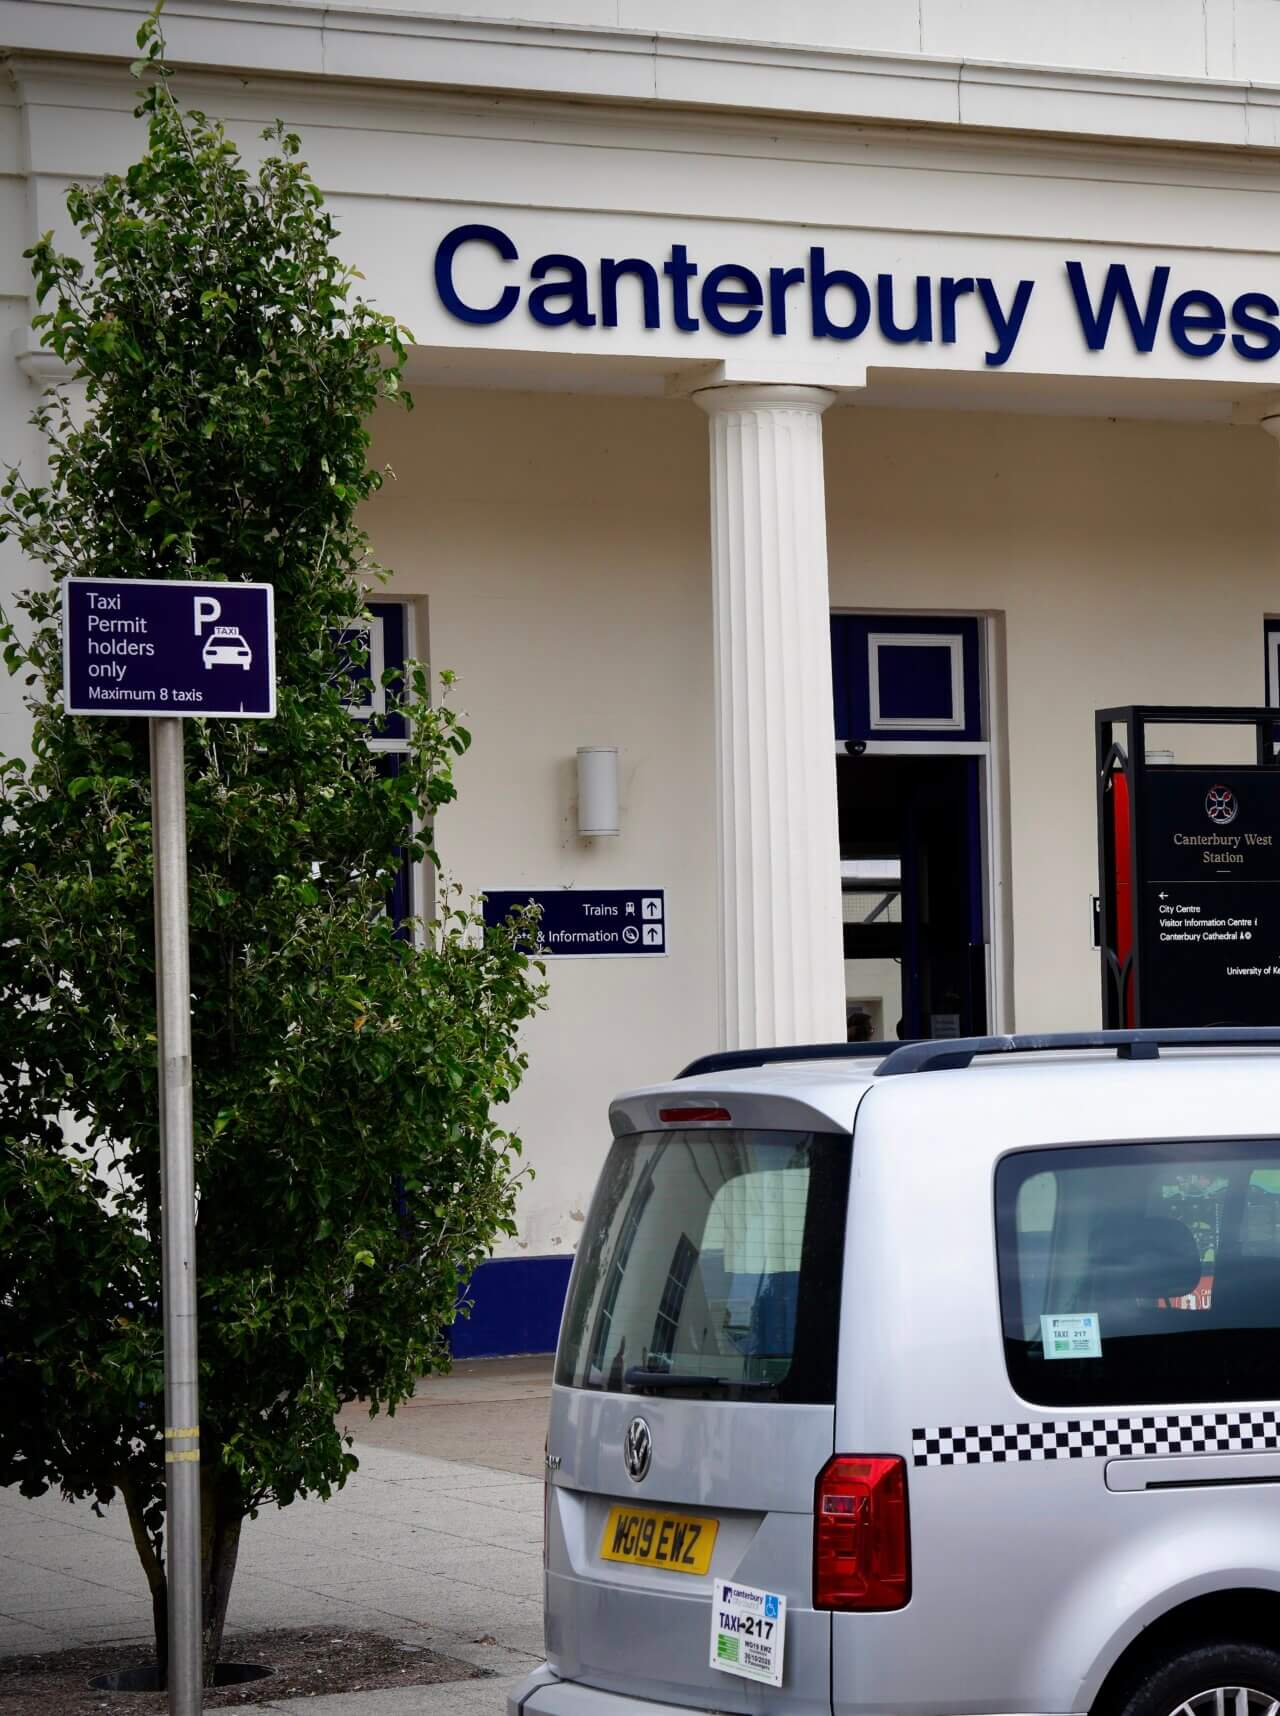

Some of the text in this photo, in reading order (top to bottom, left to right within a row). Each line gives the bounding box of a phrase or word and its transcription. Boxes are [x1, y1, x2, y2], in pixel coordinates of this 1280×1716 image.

[434, 223, 1035, 368] Canterbury
[86, 592, 222, 637] Taxi P
[88, 615, 148, 633] Permit
[215, 627, 238, 636] TAXI
[88, 638, 155, 656] holders
[88, 661, 127, 682] only
[88, 686, 203, 702] Maximum 8 taxis
[1173, 833, 1273, 849] Canterbury West
[1203, 851, 1244, 863] Station
[582, 903, 619, 916] Trains
[1159, 904, 1201, 915] City Centre
[1160, 917, 1252, 927] Visitor Information Centre
[536, 931, 546, 943] &
[548, 930, 619, 943] Information
[1160, 931, 1238, 942] Canterbury Cathedral
[1226, 966, 1262, 977] University
[1263, 965, 1272, 975] of
[612, 1514, 703, 1565] WG19 EWZ
[733, 1588, 764, 1605] canterbury
